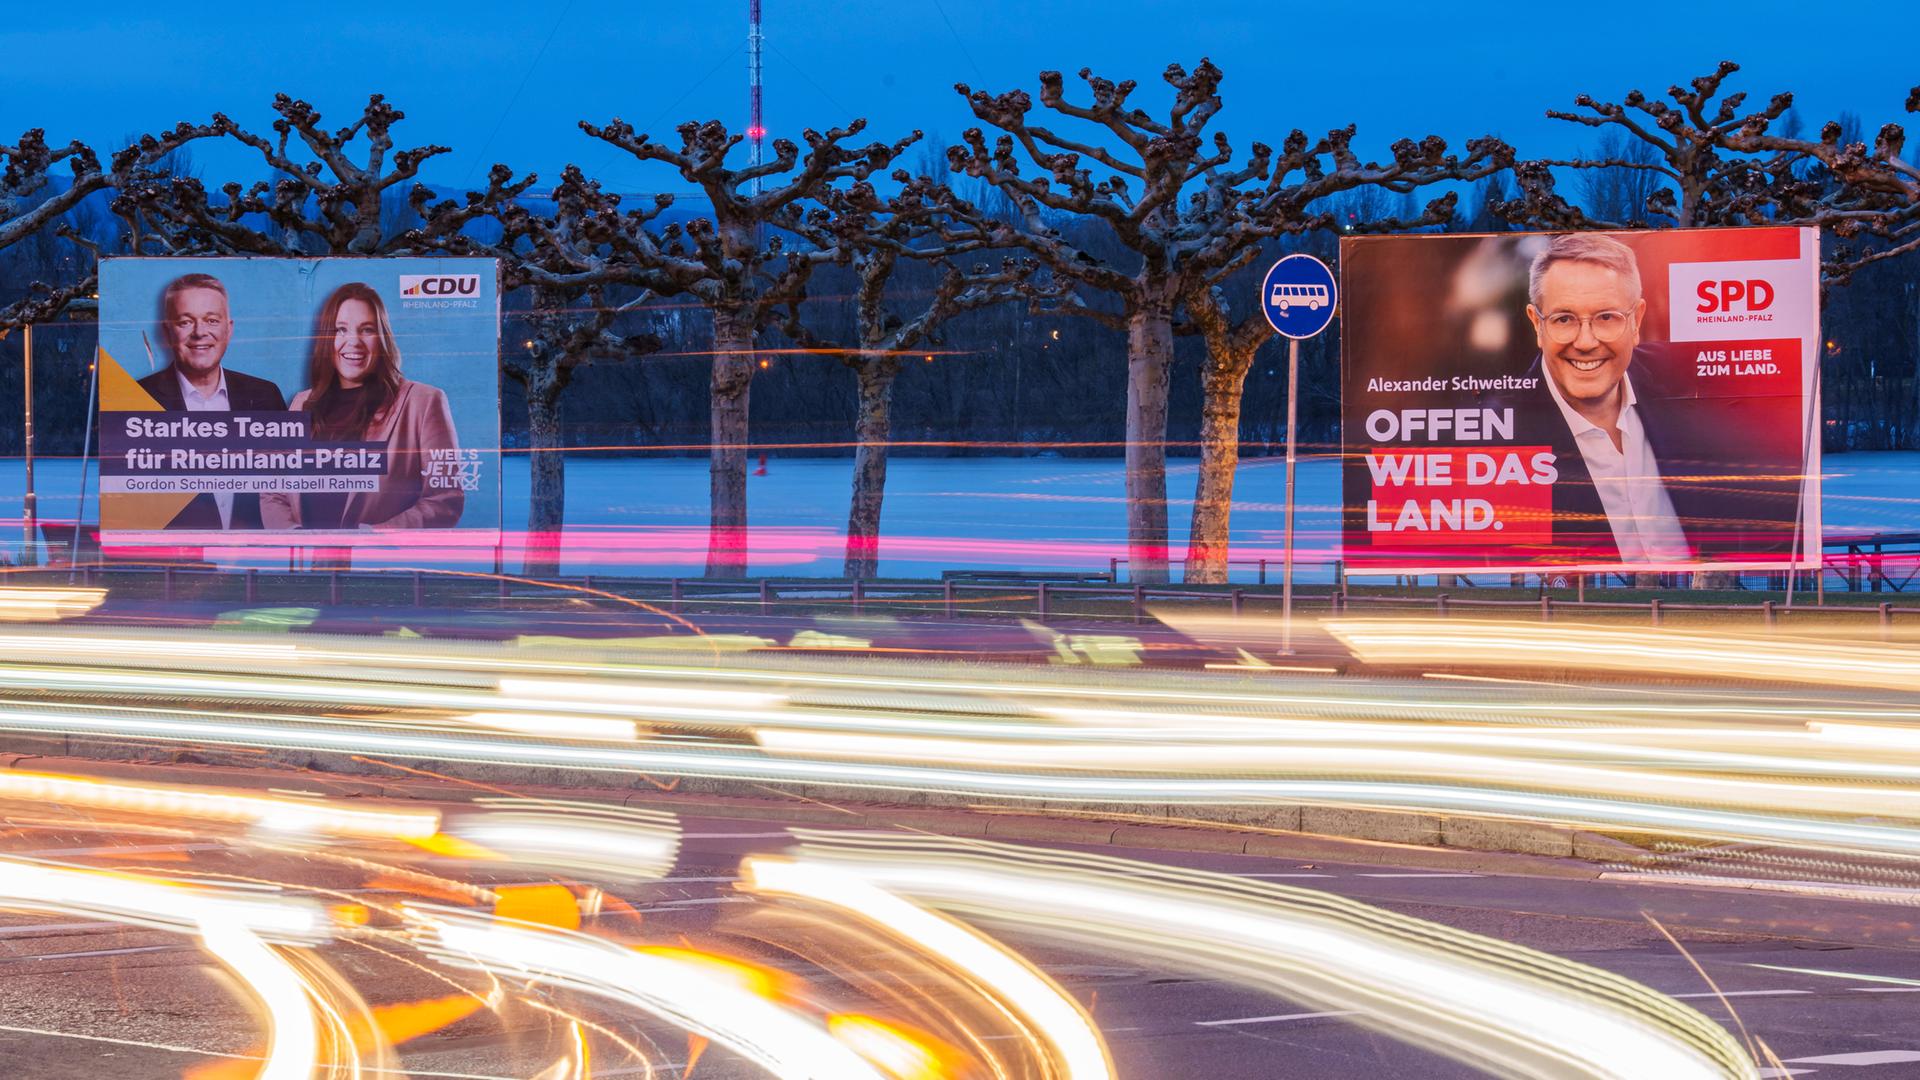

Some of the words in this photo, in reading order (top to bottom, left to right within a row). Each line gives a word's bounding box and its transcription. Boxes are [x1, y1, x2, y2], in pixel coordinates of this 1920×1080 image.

[421, 278, 476, 295] CDU
[1696, 279, 1775, 313] SPD
[402, 300, 478, 309] RHEINLAND-PFALZ
[1696, 314, 1773, 323] RHEINLAND-PFALZ
[1696, 350, 1726, 362] AUS
[1731, 349, 1772, 361] LIEBE
[1696, 365, 1730, 377] ZUM
[1735, 363, 1781, 376] LAND.
[1367, 376, 1448, 392] Alexander
[1452, 375, 1538, 391] Schweitzer
[125, 417, 229, 438] Starkes
[234, 417, 305, 438] Team
[1365, 408, 1514, 442] OFFEN
[125, 448, 166, 469] für
[171, 448, 382, 469] Rheinland-Pfalz
[429, 448, 479, 460] WEIL'S
[420, 461, 483, 476] JETZT
[1365, 453, 1452, 486] WIE
[1466, 452, 1559, 486] DAS
[125, 478, 176, 490] Gordon
[179, 478, 248, 490] Schnieder
[252, 478, 277, 490] und
[281, 478, 325, 490] Isabell
[328, 478, 375, 490] Rahms
[429, 476, 461, 488] GILT
[1367, 499, 1504, 532] LAND.
